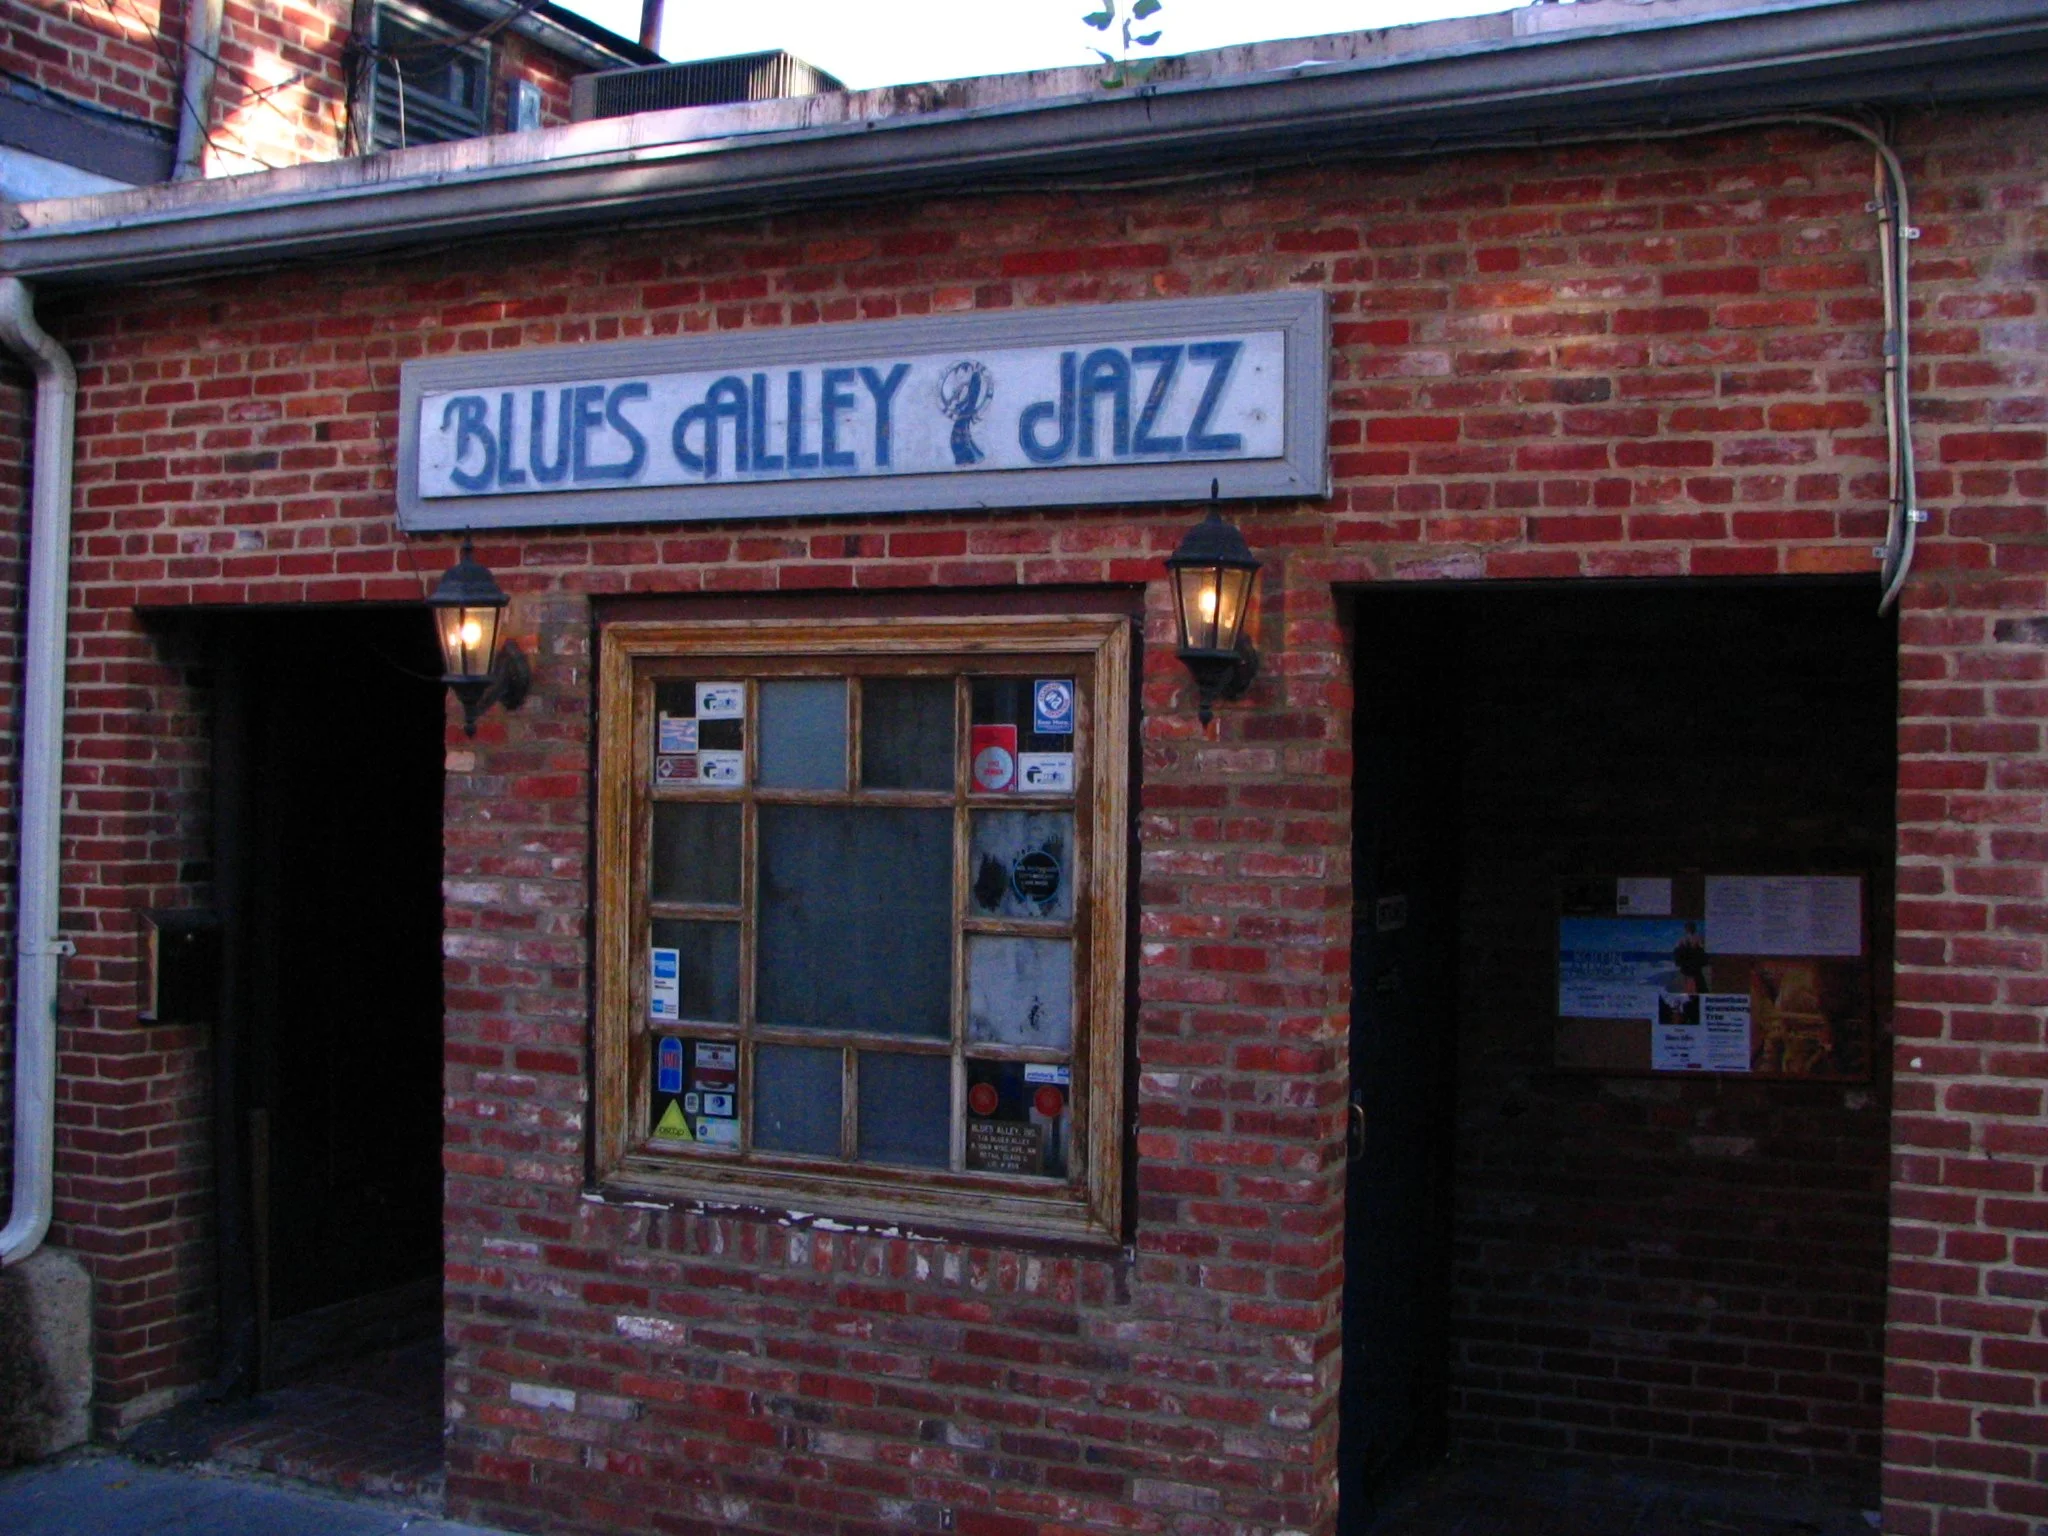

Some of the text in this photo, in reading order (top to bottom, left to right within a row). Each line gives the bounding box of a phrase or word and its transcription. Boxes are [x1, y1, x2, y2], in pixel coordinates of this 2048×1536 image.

[440, 341, 1243, 490] BLUES ALLEY JAZZ
